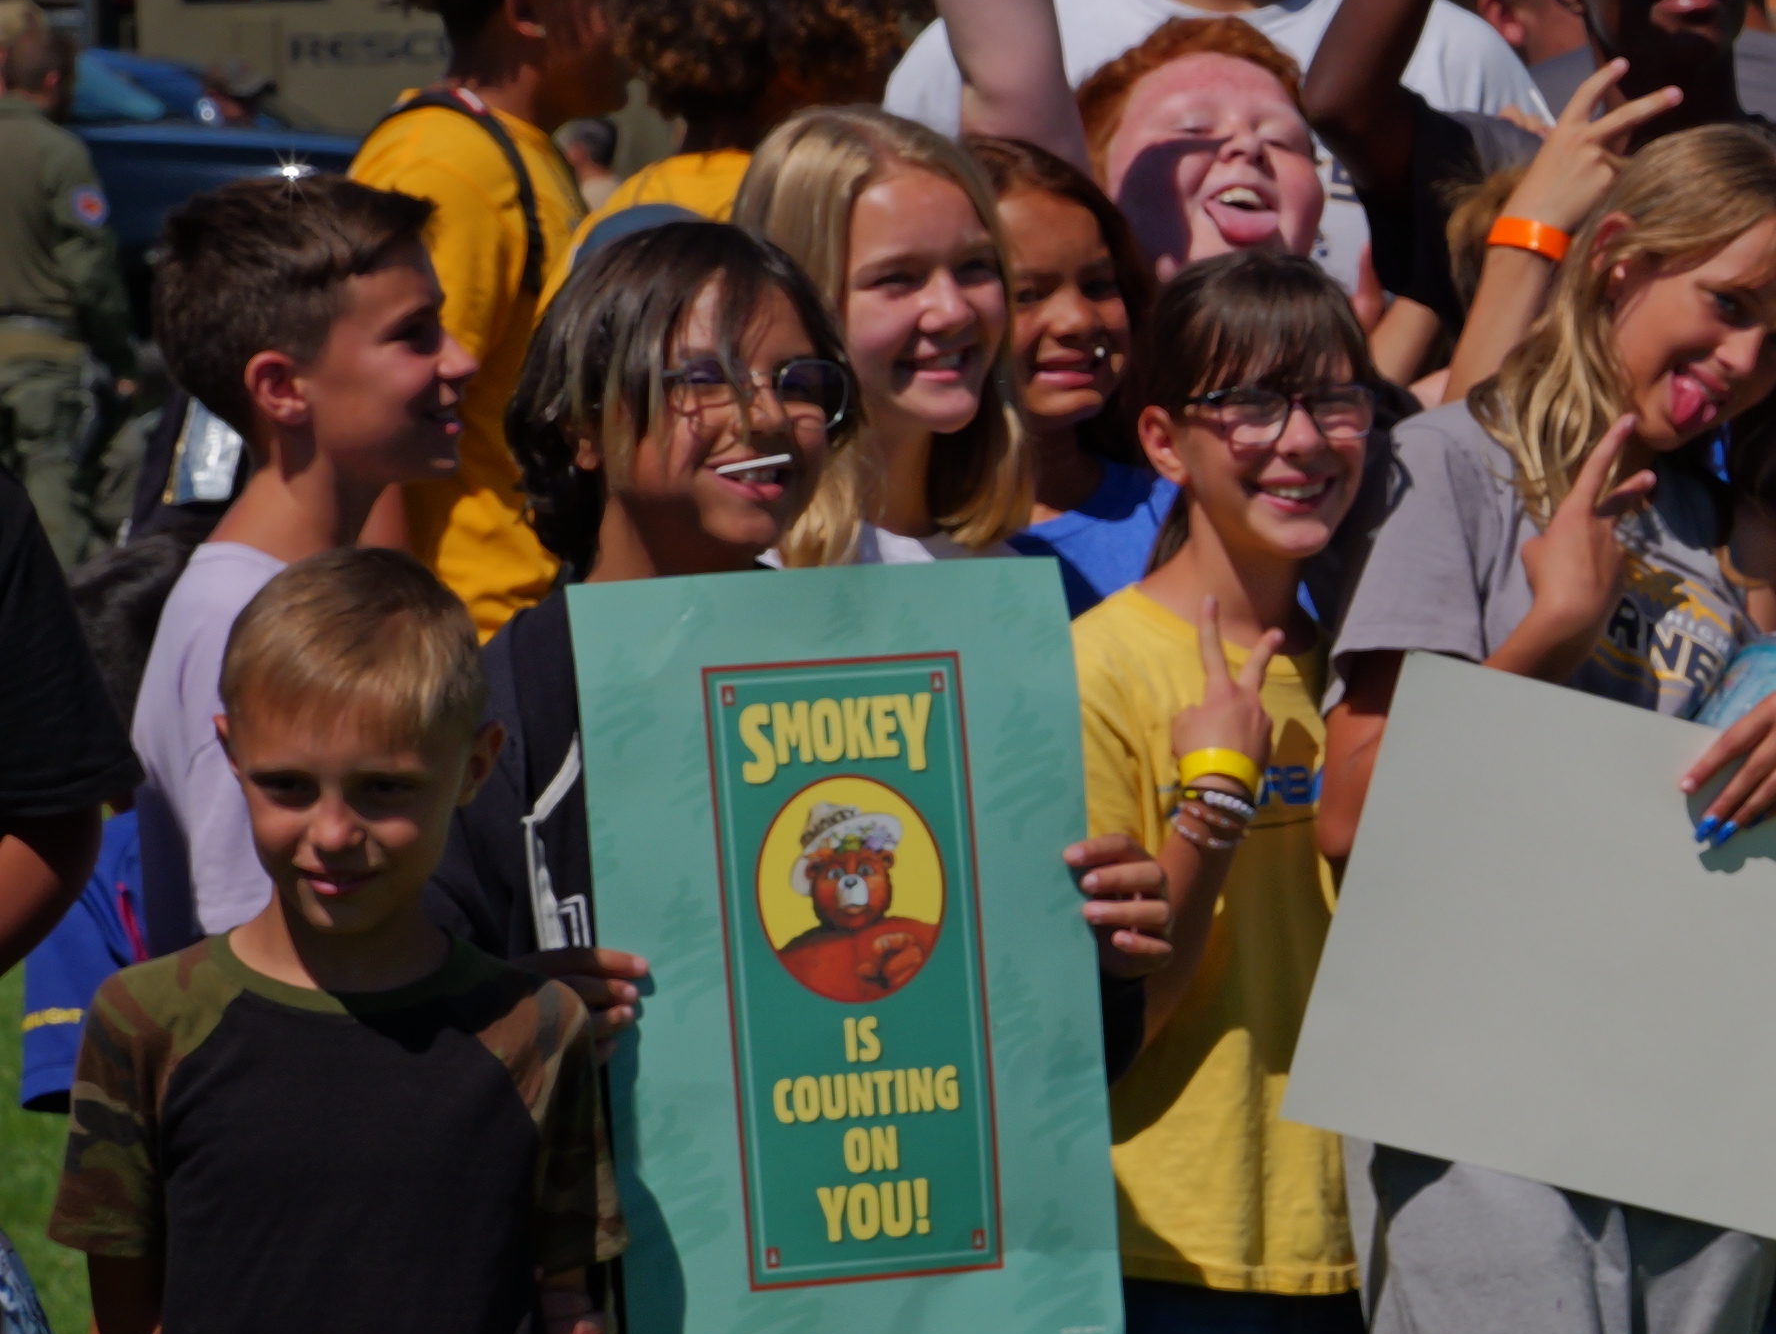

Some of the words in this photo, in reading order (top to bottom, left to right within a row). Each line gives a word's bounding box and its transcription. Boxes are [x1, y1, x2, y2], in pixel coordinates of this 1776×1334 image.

[738, 692, 932, 784] SMOKEY
[843, 1016, 881, 1062] IS
[773, 1066, 959, 1122] COUNTING
[843, 1124, 898, 1174] ON
[817, 1177, 930, 1242] YOU!
